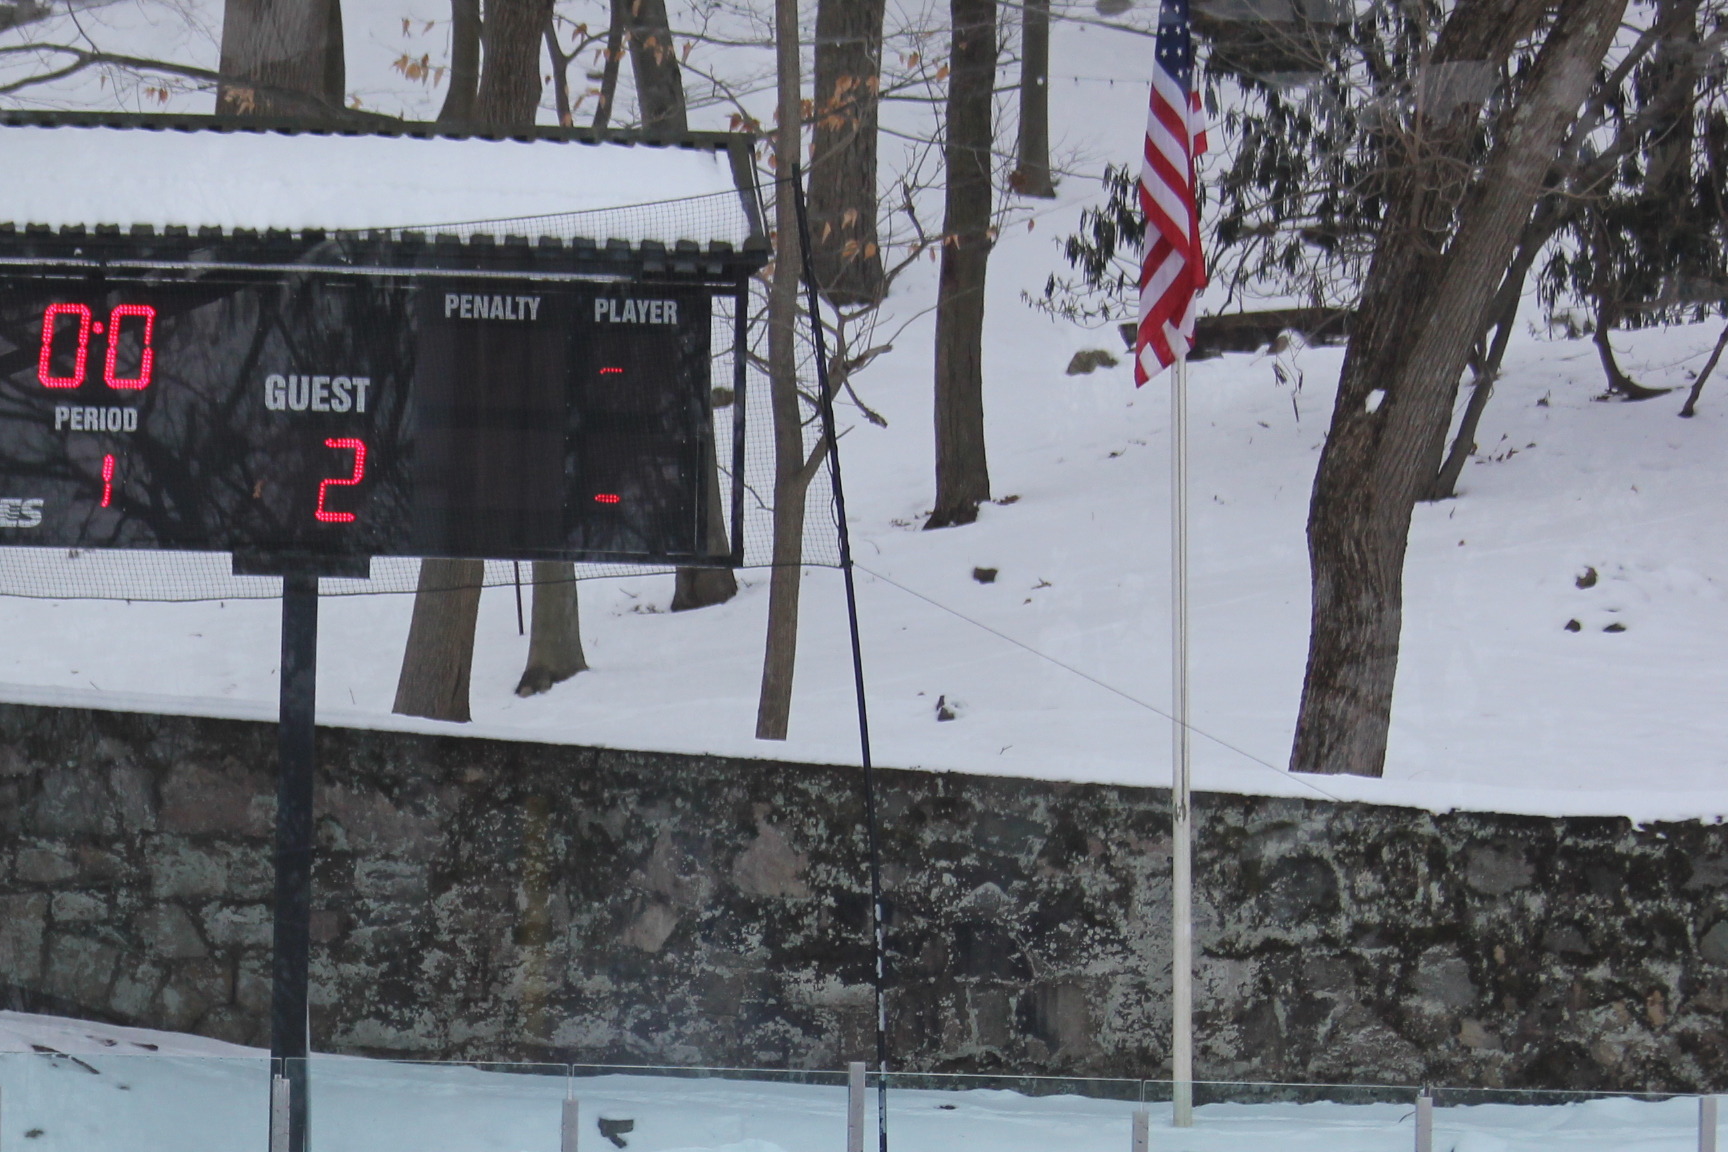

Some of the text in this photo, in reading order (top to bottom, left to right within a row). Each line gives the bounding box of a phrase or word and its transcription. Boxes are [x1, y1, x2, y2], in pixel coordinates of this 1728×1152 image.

[444, 293, 541, 321] PENALTY
[593, 298, 678, 326] PLAYER
[264, 373, 371, 414] GUEST
[54, 406, 138, 433] PERIOD
[100, 453, 114, 508] 1
[315, 437, 366, 523] 2
